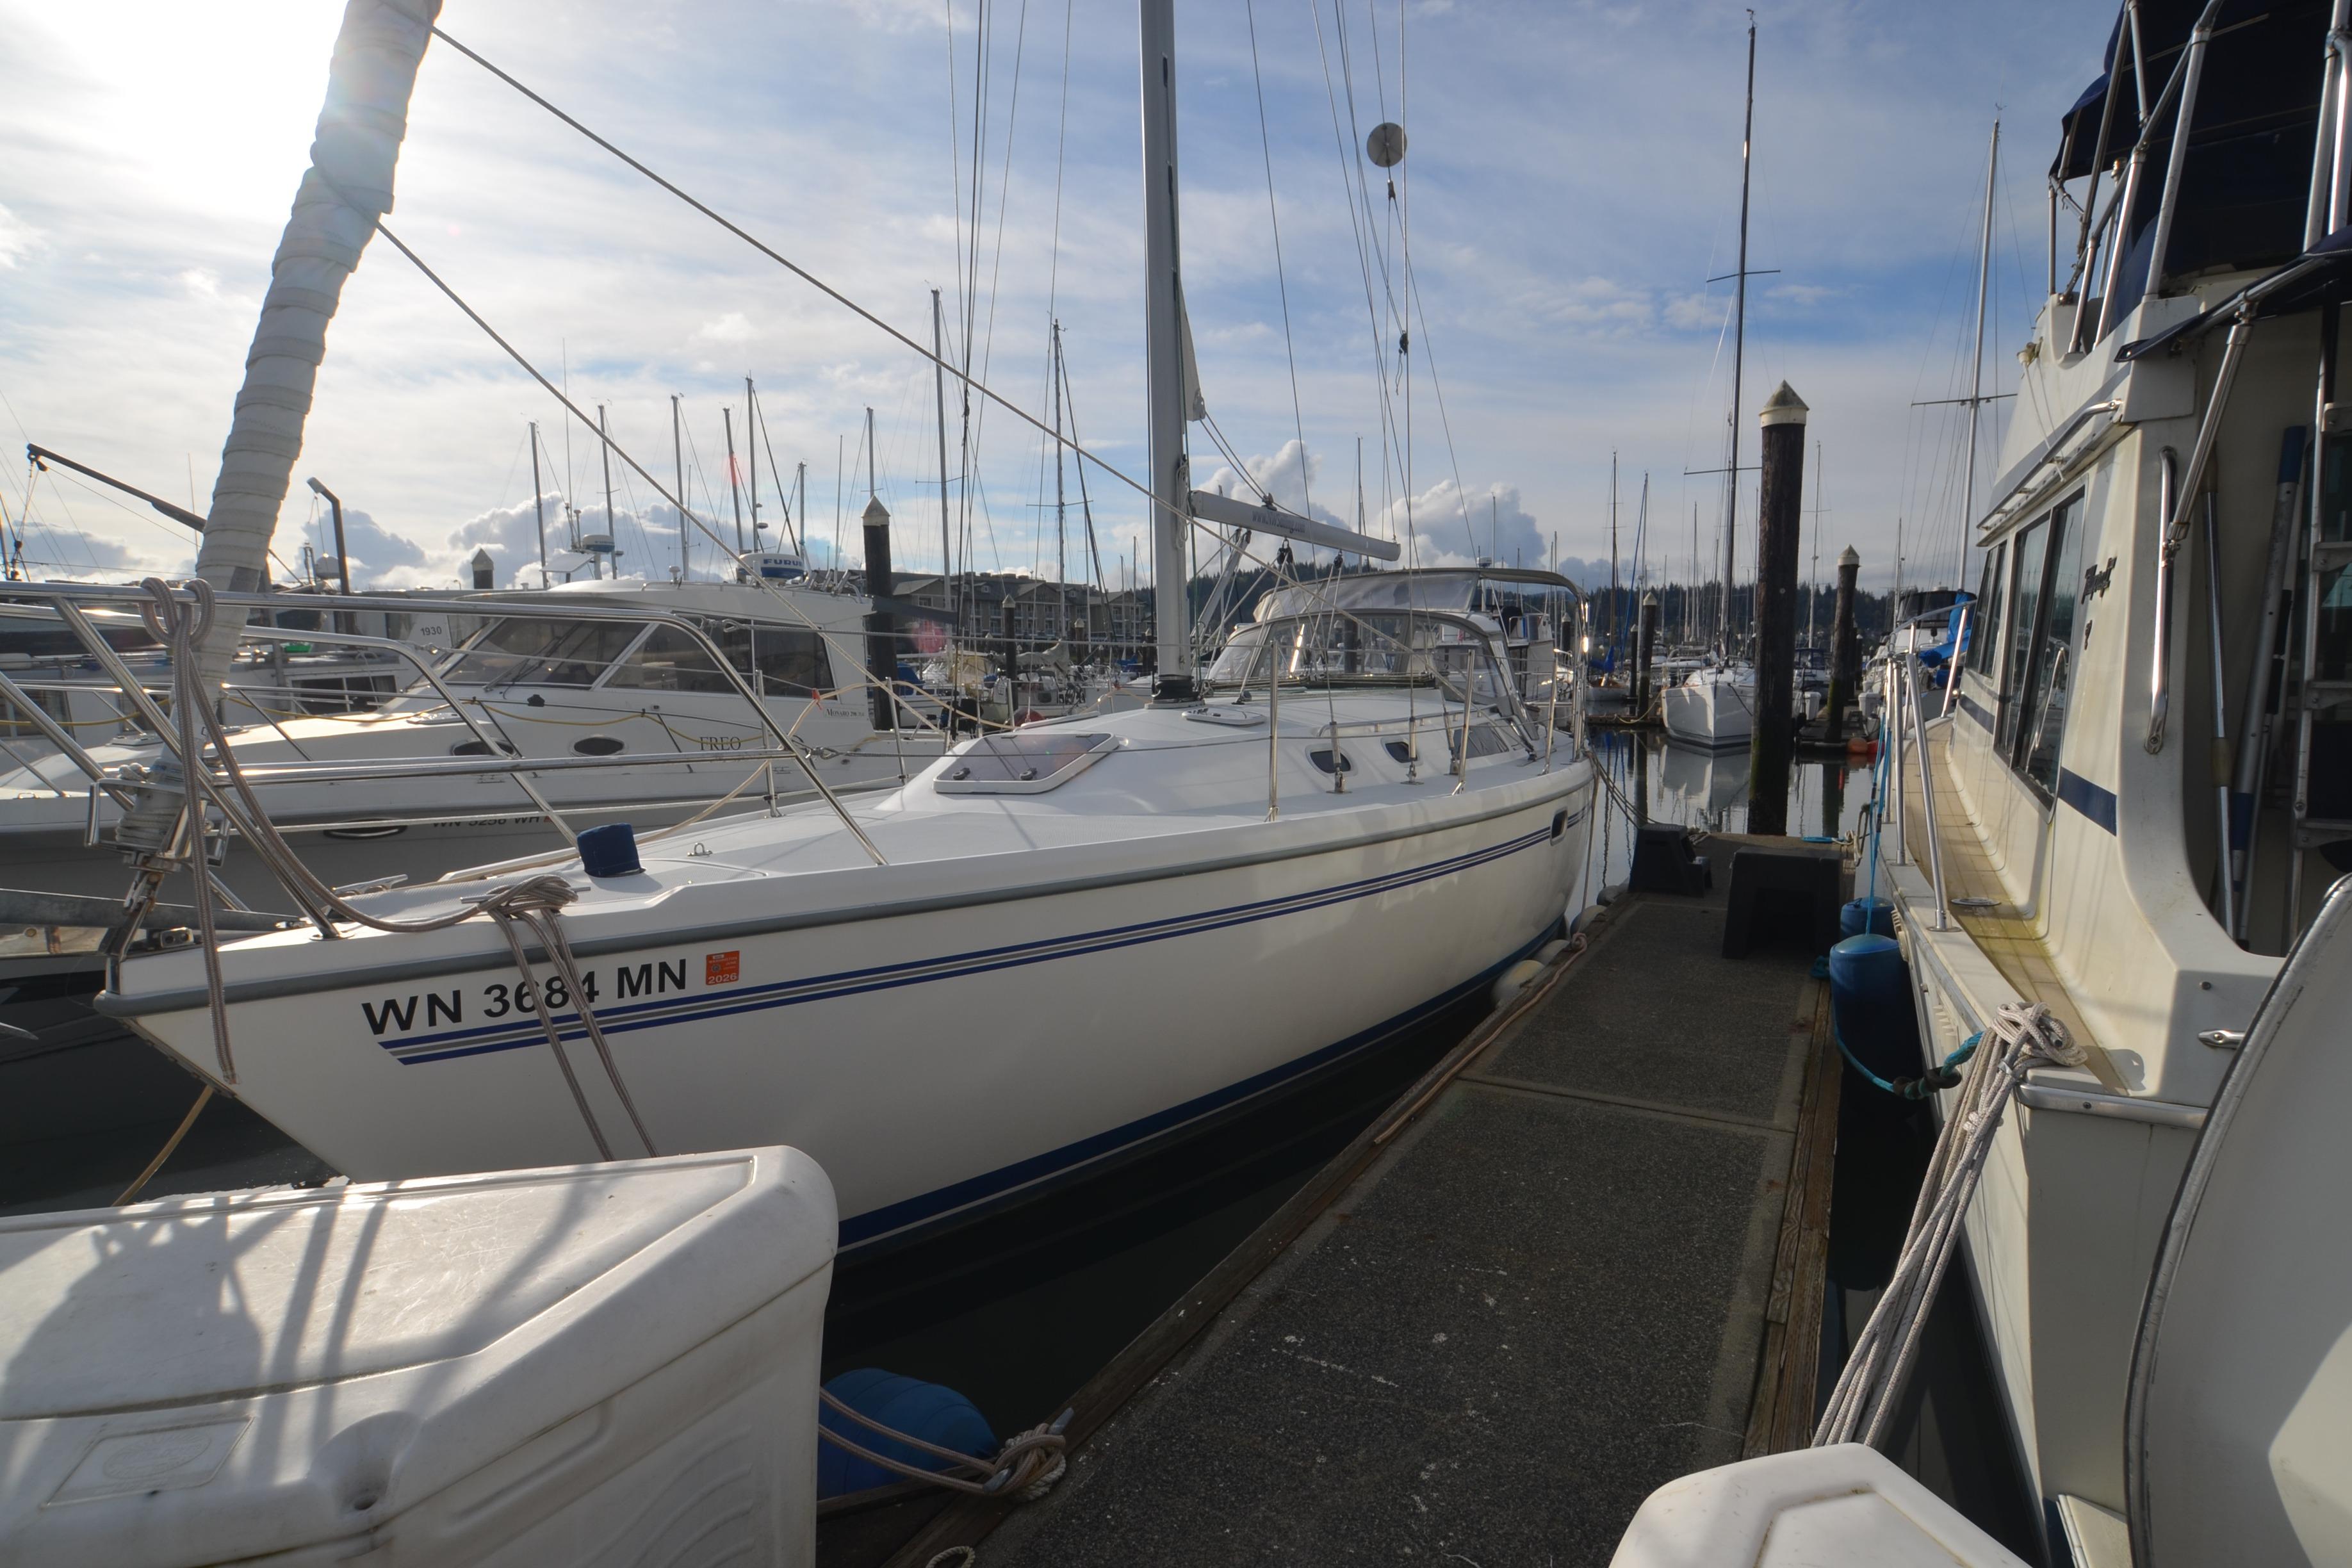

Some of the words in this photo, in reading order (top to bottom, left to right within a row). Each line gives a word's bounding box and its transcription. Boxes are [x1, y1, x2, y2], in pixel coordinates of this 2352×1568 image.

[420, 626, 442, 636] 1930
[699, 736, 741, 751] FREO
[708, 972, 737, 984] 2026
[361, 990, 462, 1035] WN
[484, 970, 600, 1018] 3684
[617, 958, 686, 999] MN
